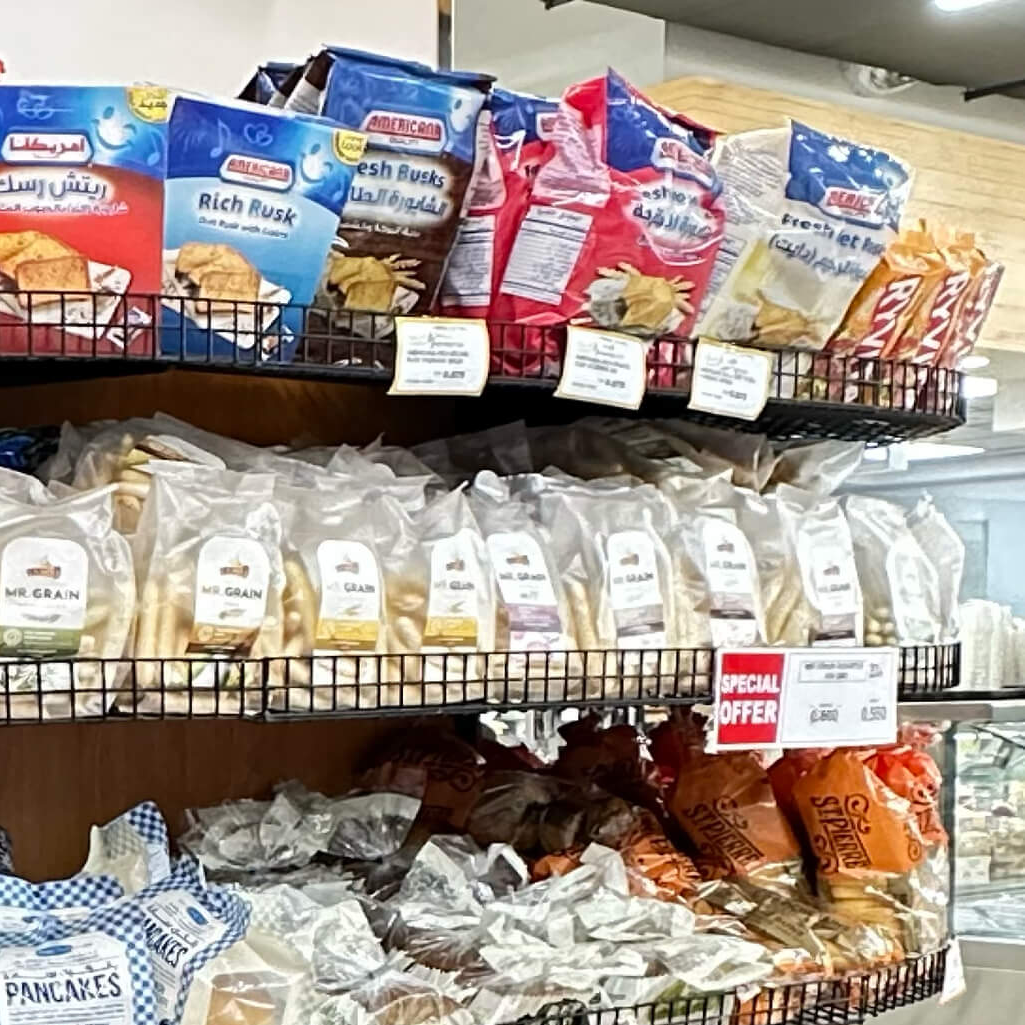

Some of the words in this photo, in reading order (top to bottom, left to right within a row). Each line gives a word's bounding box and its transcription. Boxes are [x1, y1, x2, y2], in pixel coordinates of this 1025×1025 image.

[367, 114, 442, 140] AMERICANA
[48, 171, 107, 200] ريتش
[357, 160, 392, 177] esh
[397, 163, 445, 189] Rusks
[198, 192, 244, 213] Rich
[248, 197, 297, 227] Rusk
[32, 588, 81, 601] GRAIN
[224, 586, 263, 599] GRAIN
[721, 674, 780, 694] SPECIAL
[720, 700, 778, 725] OFFER
[702, 821, 762, 867] PIERRE
[820, 817, 868, 870] PIERRE
[5, 971, 122, 1007] PANCAKES
